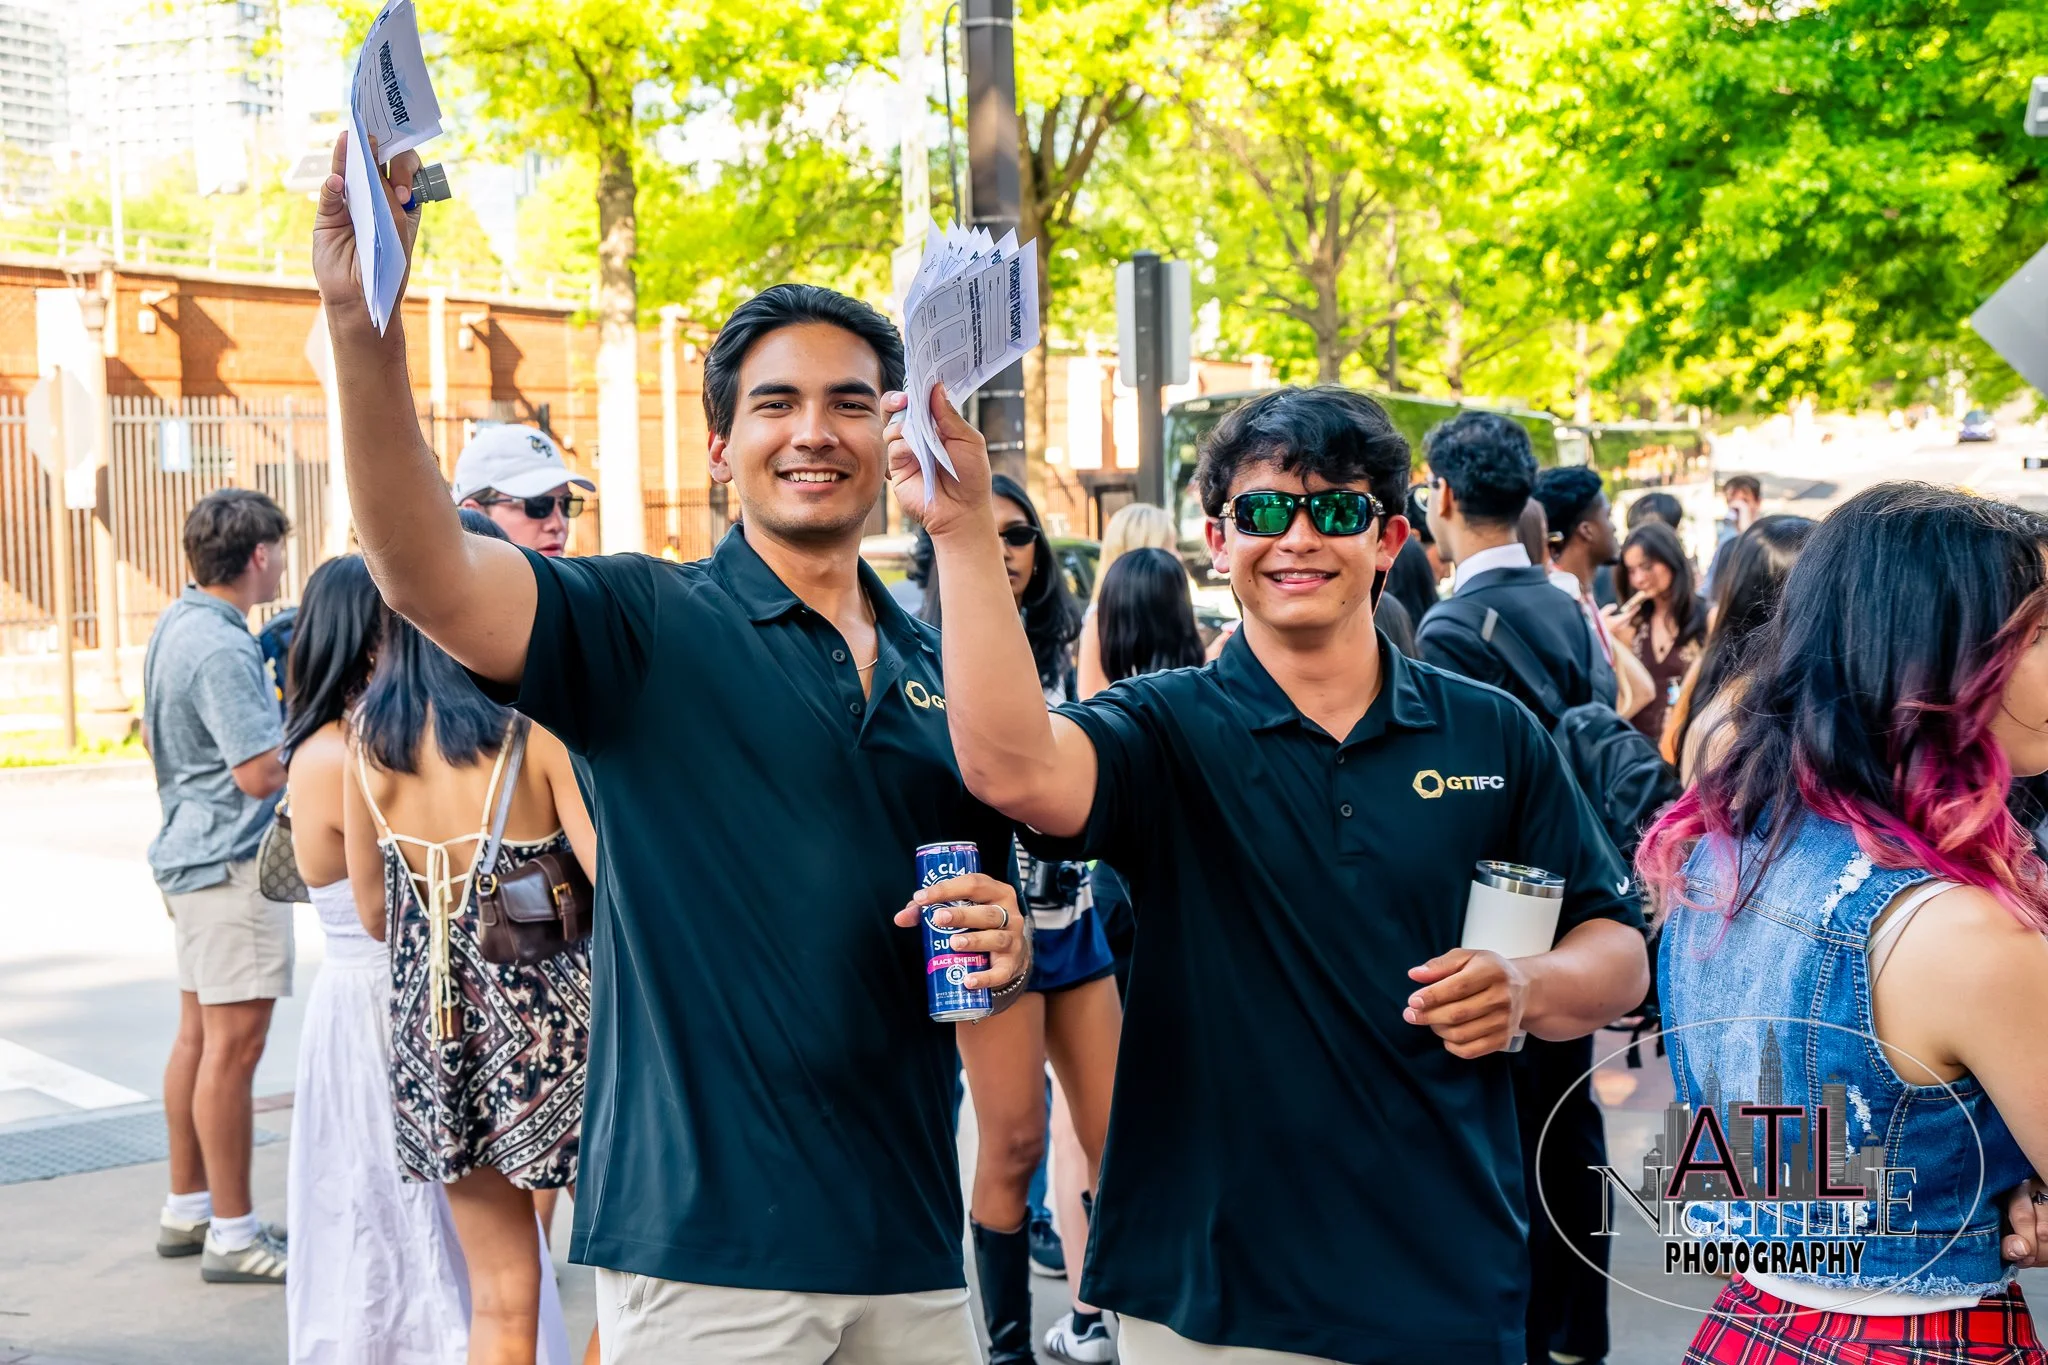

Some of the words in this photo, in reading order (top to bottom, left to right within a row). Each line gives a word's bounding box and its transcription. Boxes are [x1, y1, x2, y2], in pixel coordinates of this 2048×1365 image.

[379, 40, 396, 85] PORCHFEST
[385, 81, 410, 126] PASSPORT
[1009, 257, 1020, 302] PORCHFEST
[1010, 301, 1022, 342] PASSPORT
[1446, 776, 1504, 790] GTIFC
[938, 862, 970, 876] CLA
[933, 957, 952, 966] BLACK
[953, 955, 977, 964] CHERRY
